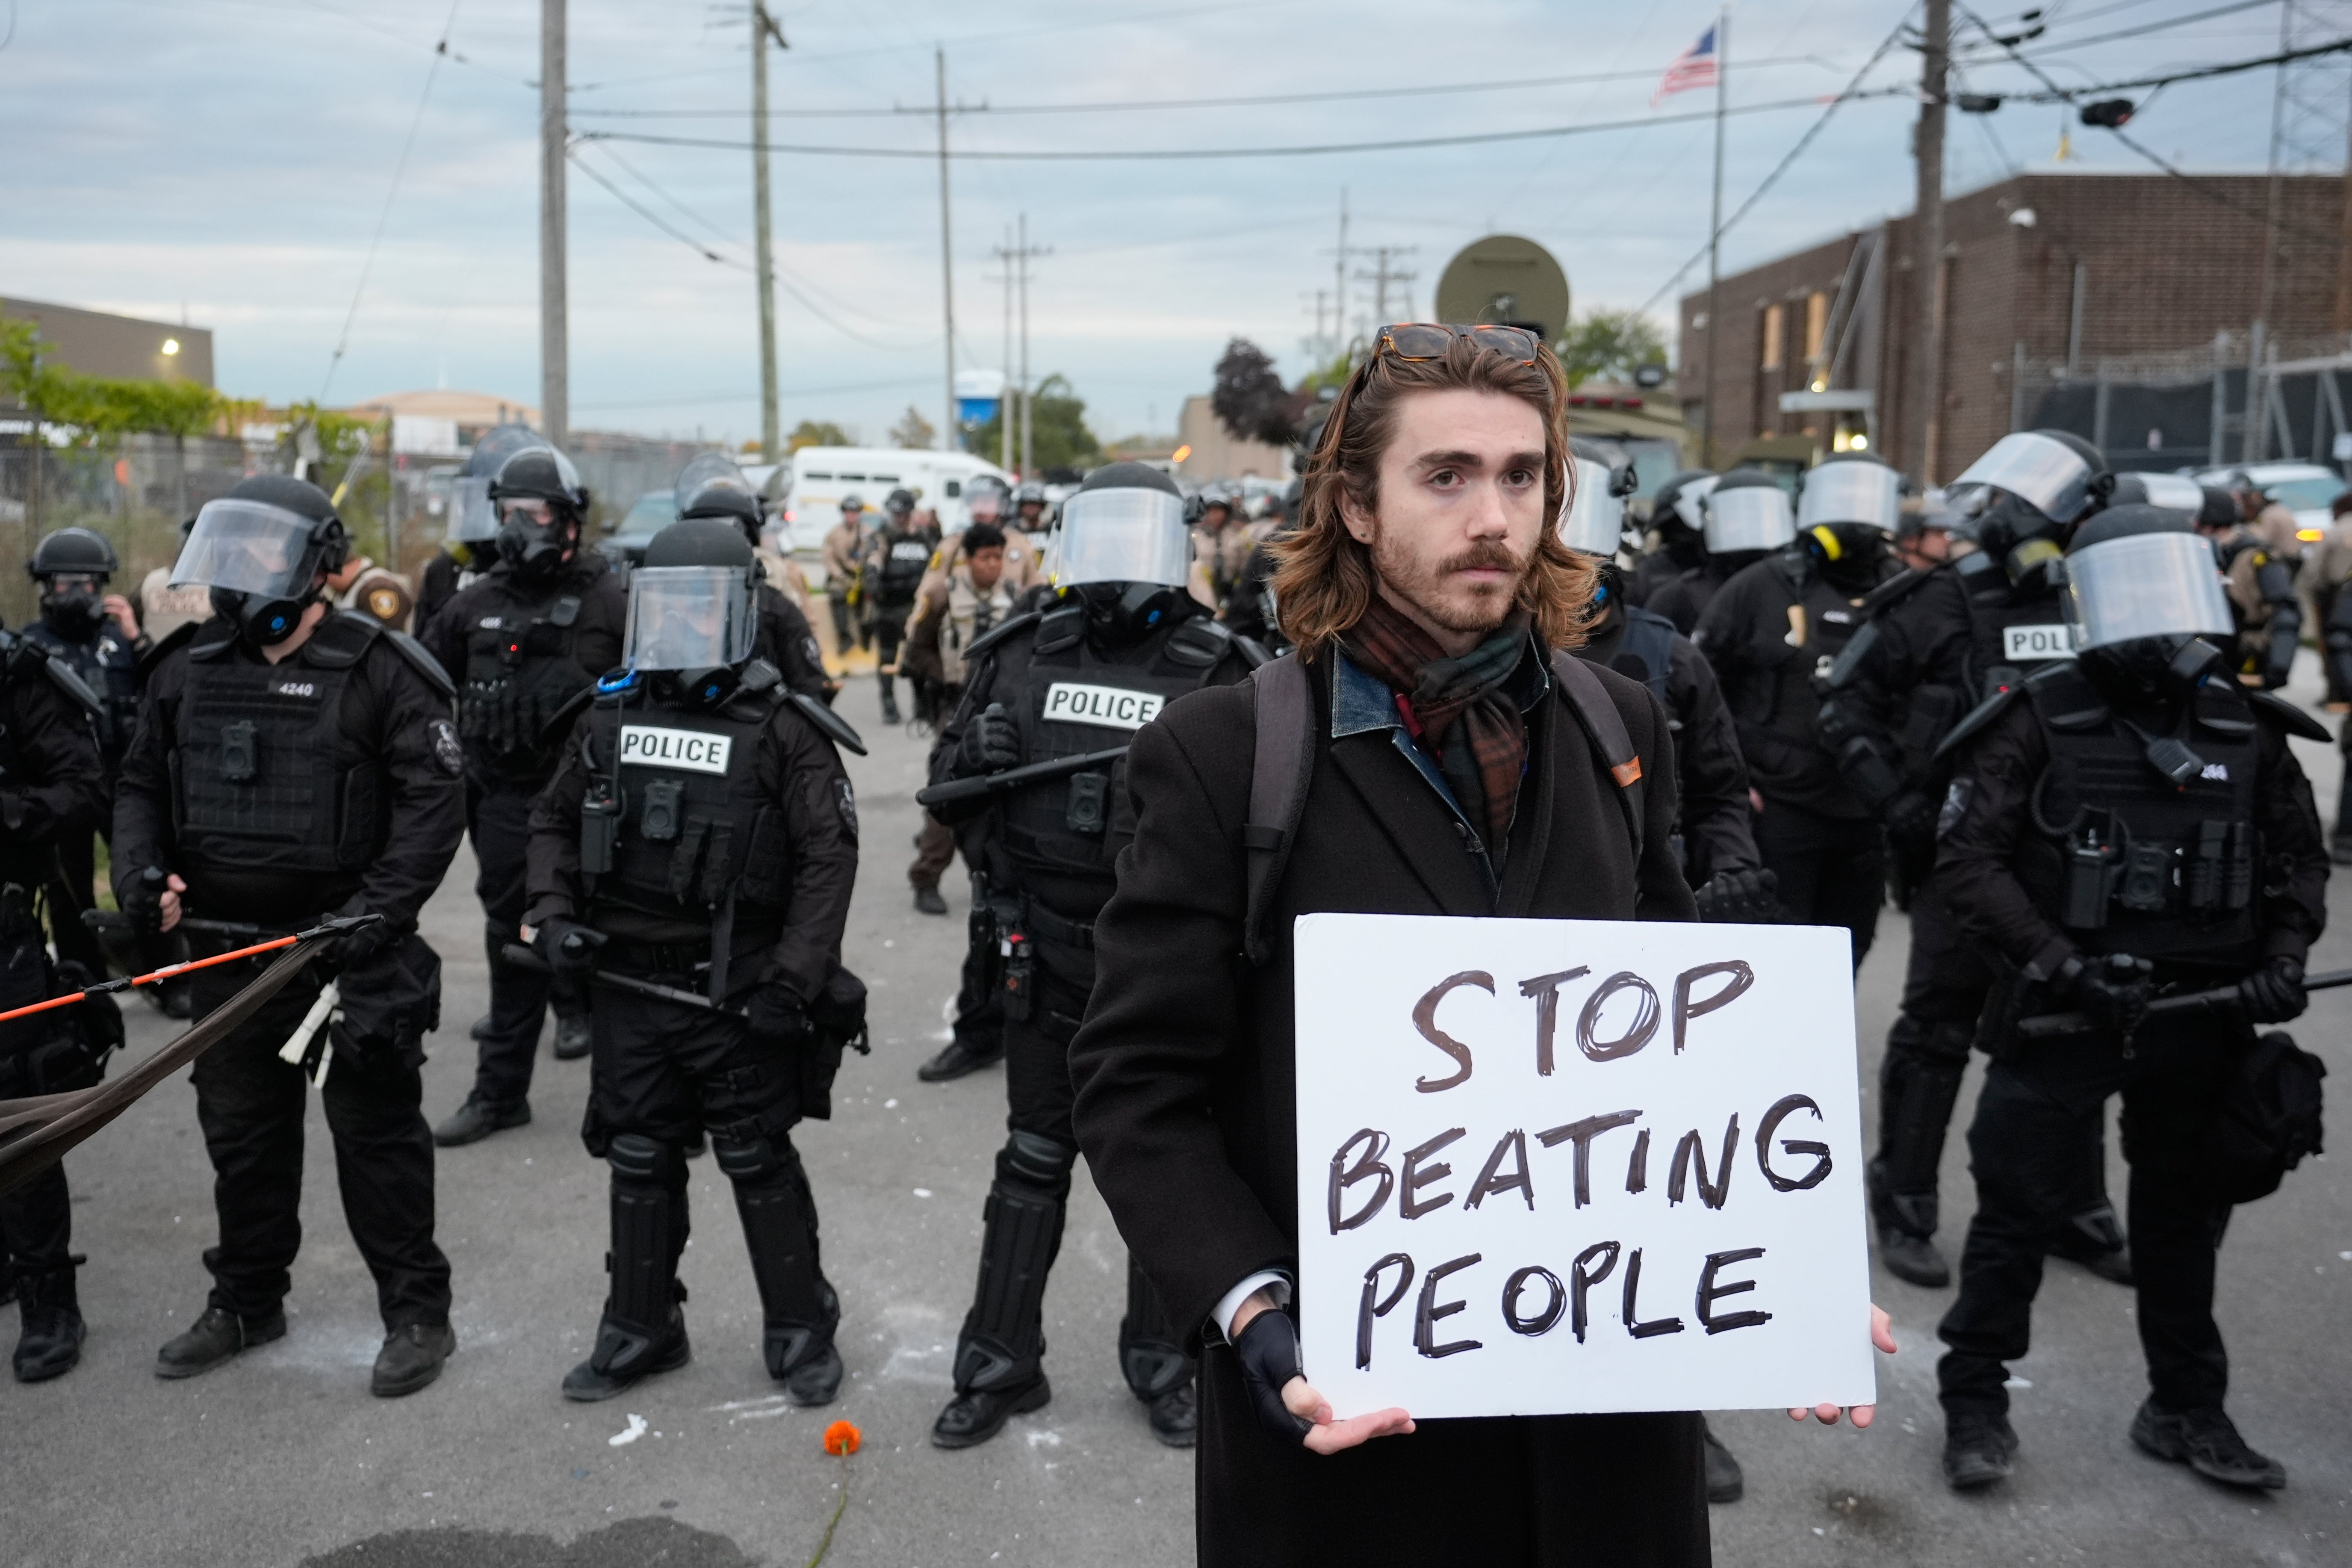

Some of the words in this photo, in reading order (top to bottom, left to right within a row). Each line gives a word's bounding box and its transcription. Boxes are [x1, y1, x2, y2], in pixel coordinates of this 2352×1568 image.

[2013, 632, 2069, 652] POL
[279, 683, 314, 697] 4240
[1051, 691, 1154, 723] POLICE
[622, 734, 722, 765] POLICE
[1412, 959, 1754, 1093] STOP
[1327, 1093, 1833, 1235] BEATING
[1355, 1240, 1772, 1371] PEOPLE
